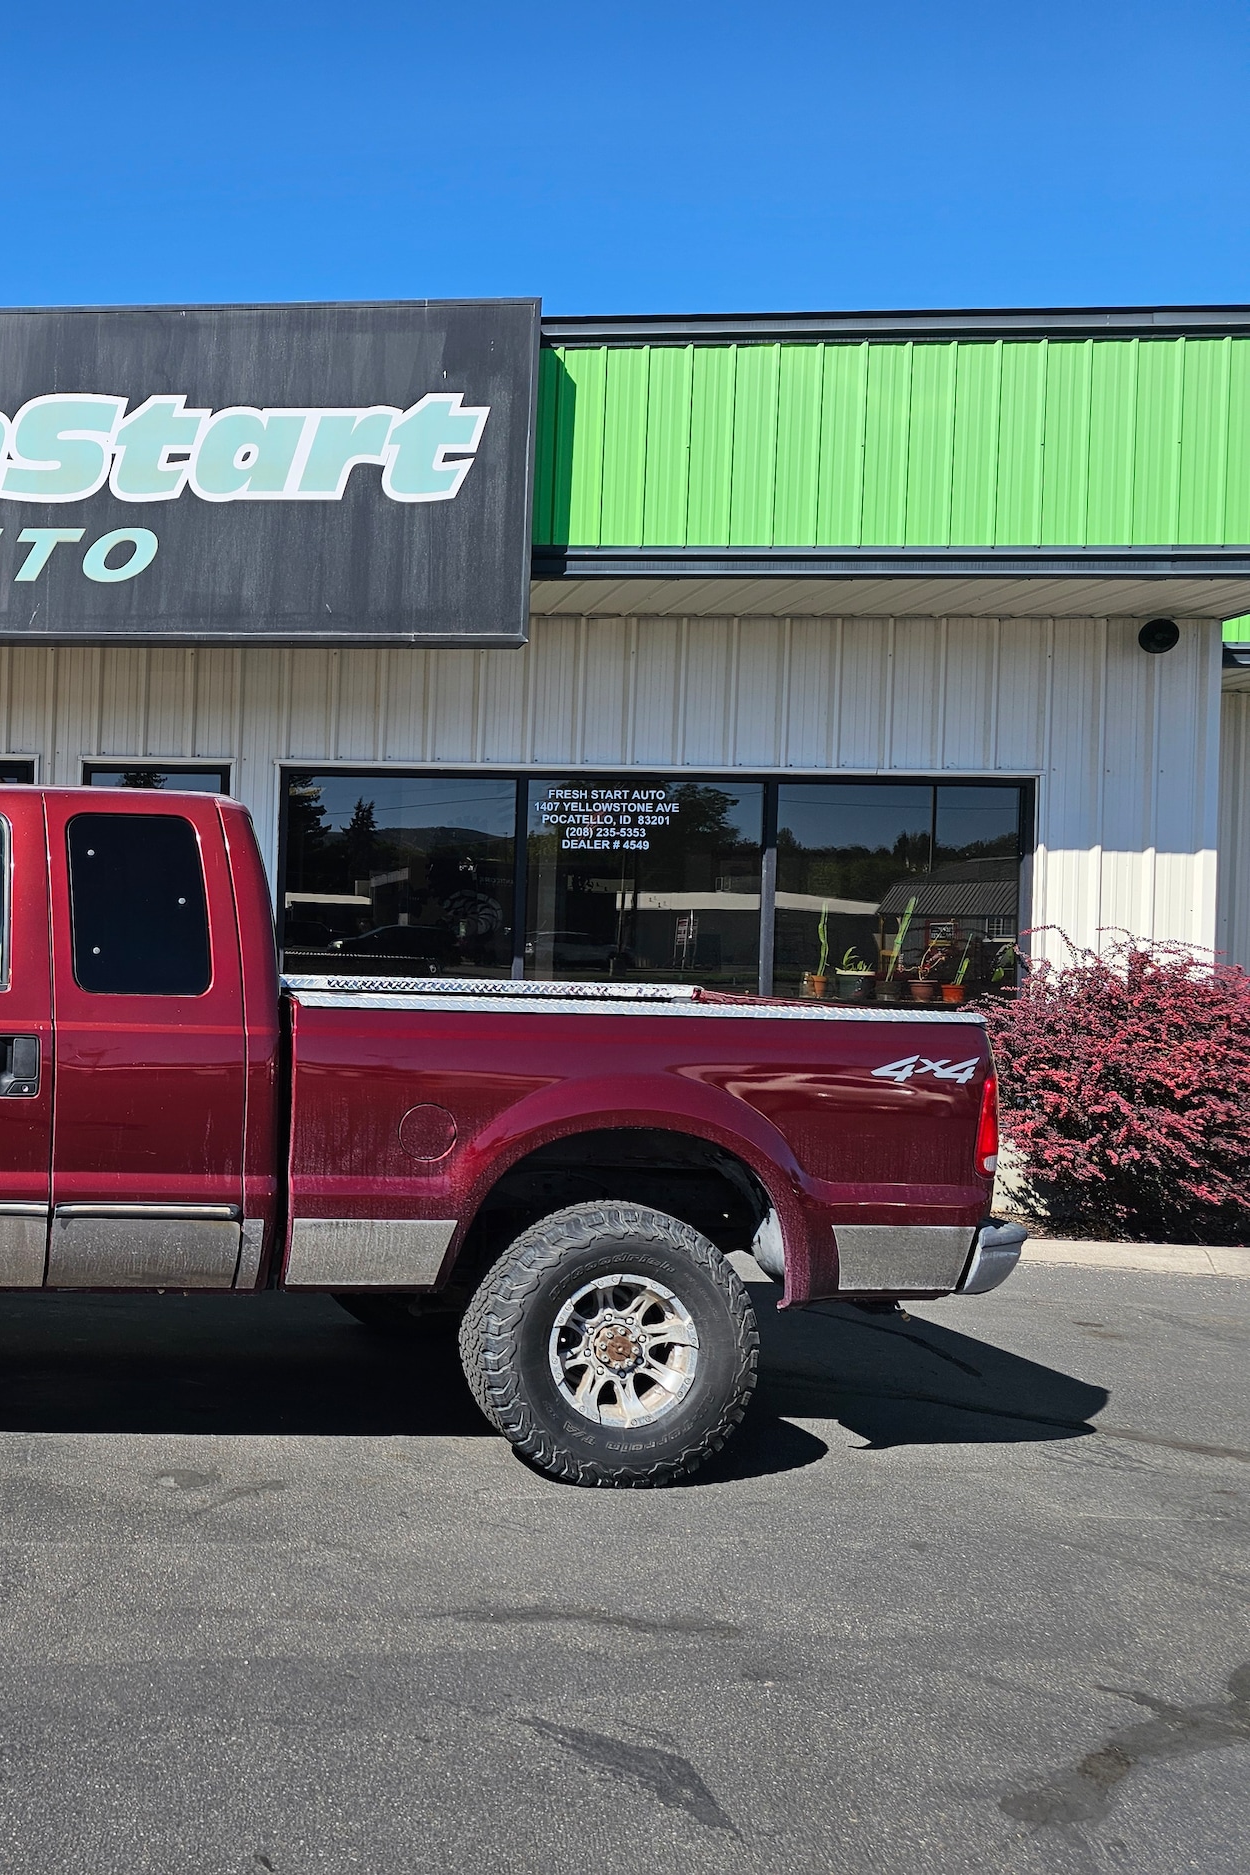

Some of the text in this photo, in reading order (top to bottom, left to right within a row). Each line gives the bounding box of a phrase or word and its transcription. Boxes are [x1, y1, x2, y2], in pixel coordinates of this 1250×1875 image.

[548, 790, 665, 801] FRESH START AUTO
[534, 802, 680, 813] 1407 YELLOWSTONE AVE
[542, 814, 670, 826] POCATELLO, ID 83201
[565, 827, 646, 839] (208) 235-5353
[562, 840, 650, 850] DEALER # 4549
